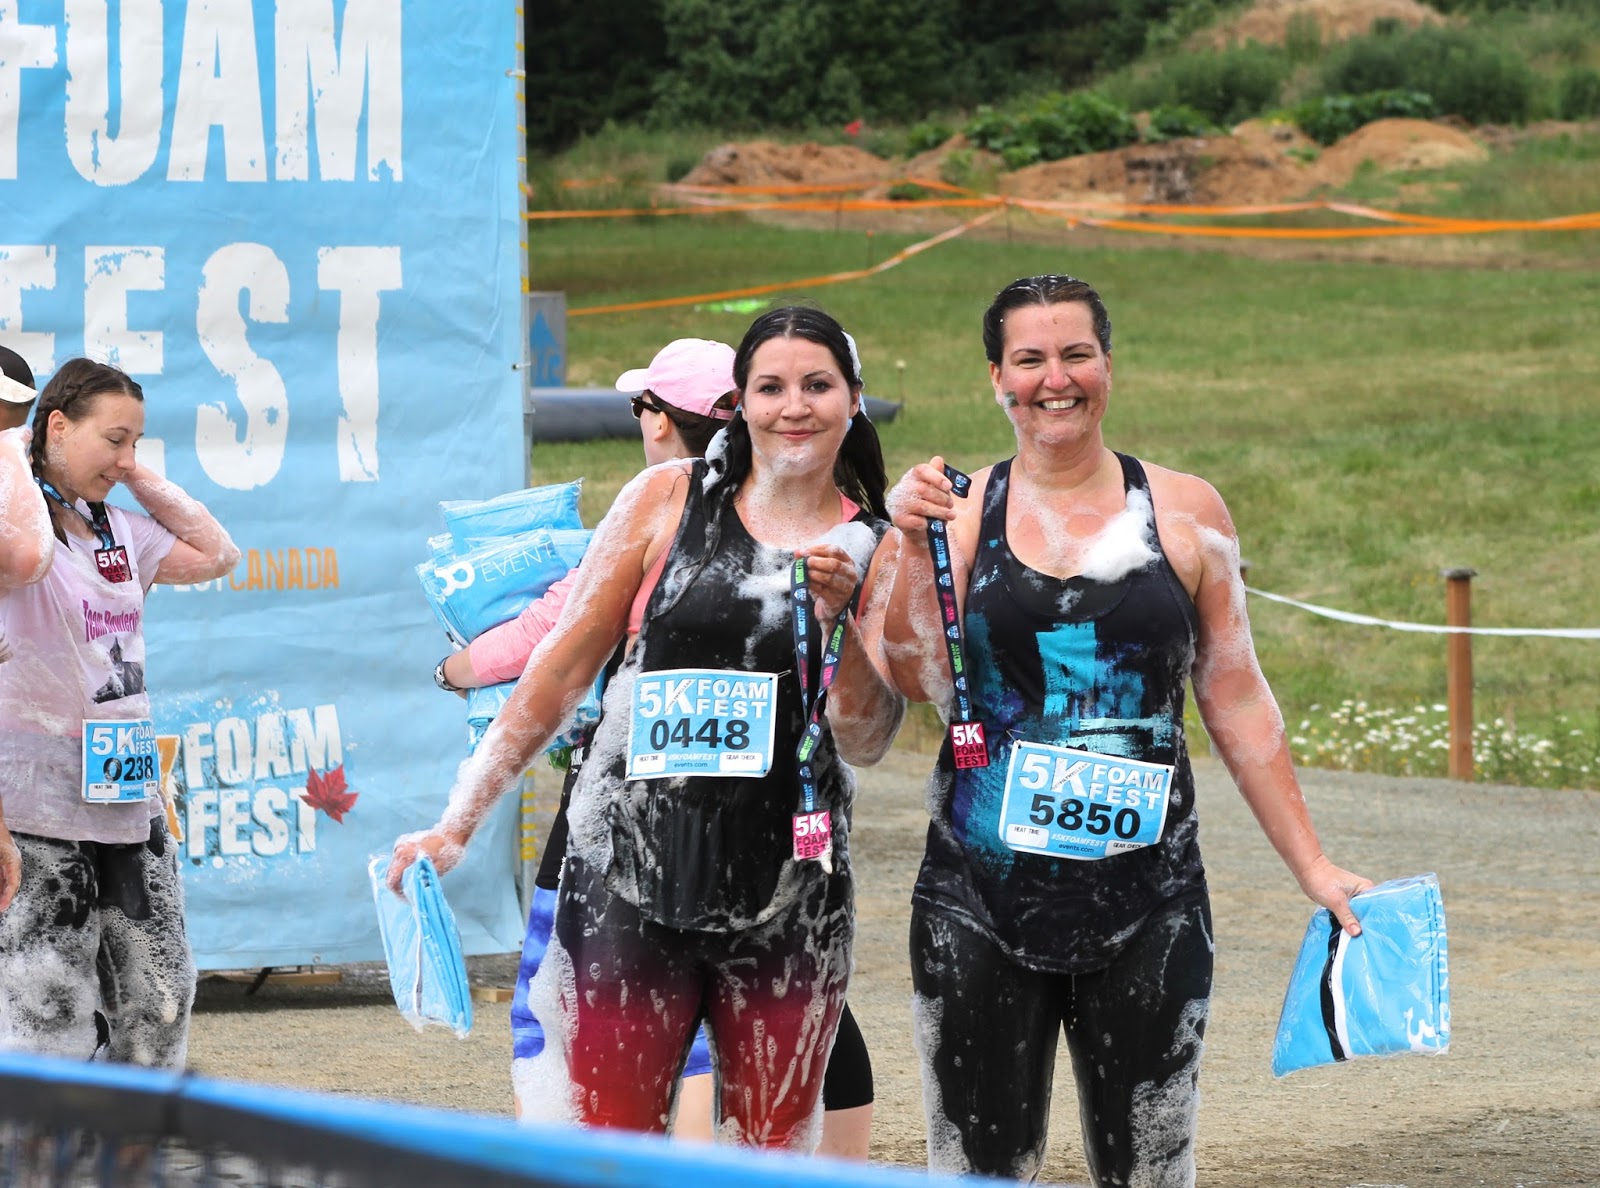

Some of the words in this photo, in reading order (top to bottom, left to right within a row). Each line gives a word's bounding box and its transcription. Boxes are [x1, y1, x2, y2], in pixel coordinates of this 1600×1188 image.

[97, 550, 126, 568] 5K
[639, 678, 696, 718] 5K
[697, 679, 769, 699] FOAM
[696, 698, 768, 719] FEST
[91, 727, 136, 755] 5K
[183, 704, 343, 789] FOAM
[650, 718, 750, 750] 0448
[953, 724, 983, 746] 5K
[955, 745, 983, 755] FOAM
[957, 755, 986, 767] FEST
[103, 755, 153, 781] 0238
[1018, 753, 1094, 797] 5K
[1091, 763, 1164, 791] FOAM
[1089, 782, 1160, 809] FEST
[188, 787, 316, 857] FEST
[795, 812, 828, 837] 5K
[1029, 793, 1140, 839] 5850
[796, 832, 828, 847] FOAM
